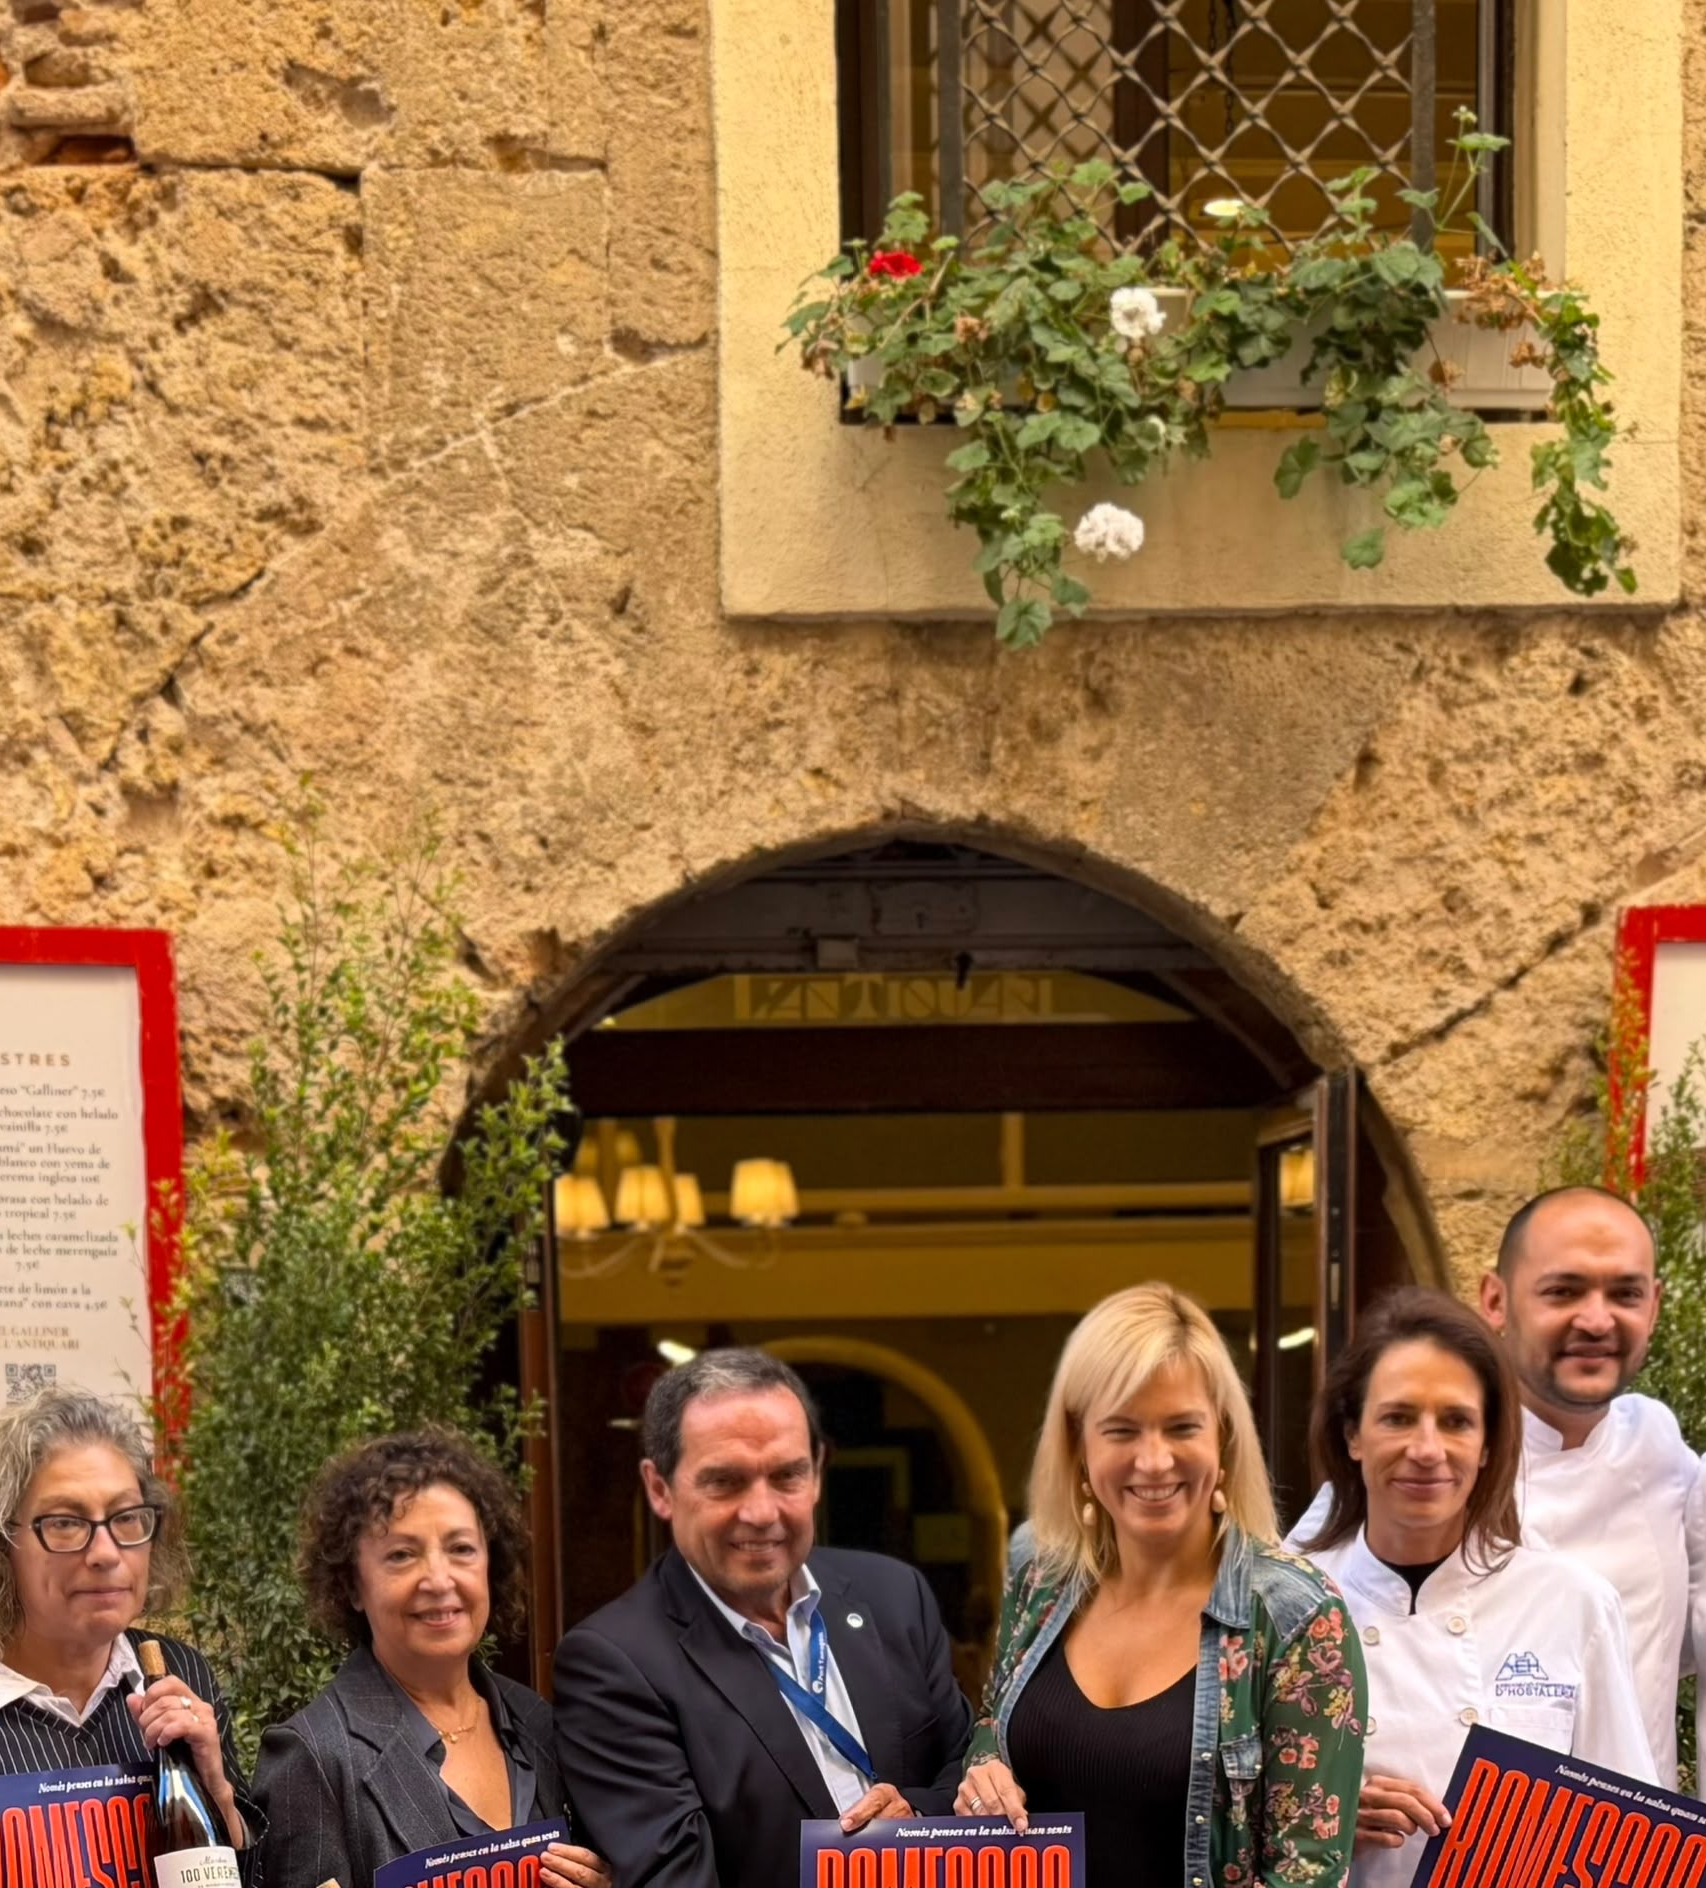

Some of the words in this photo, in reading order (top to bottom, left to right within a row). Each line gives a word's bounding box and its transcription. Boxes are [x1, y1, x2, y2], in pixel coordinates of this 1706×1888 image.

[56, 1110, 77, 1119] con
[80, 1108, 118, 1120] helado
[181, 1868, 200, 1883] 100
